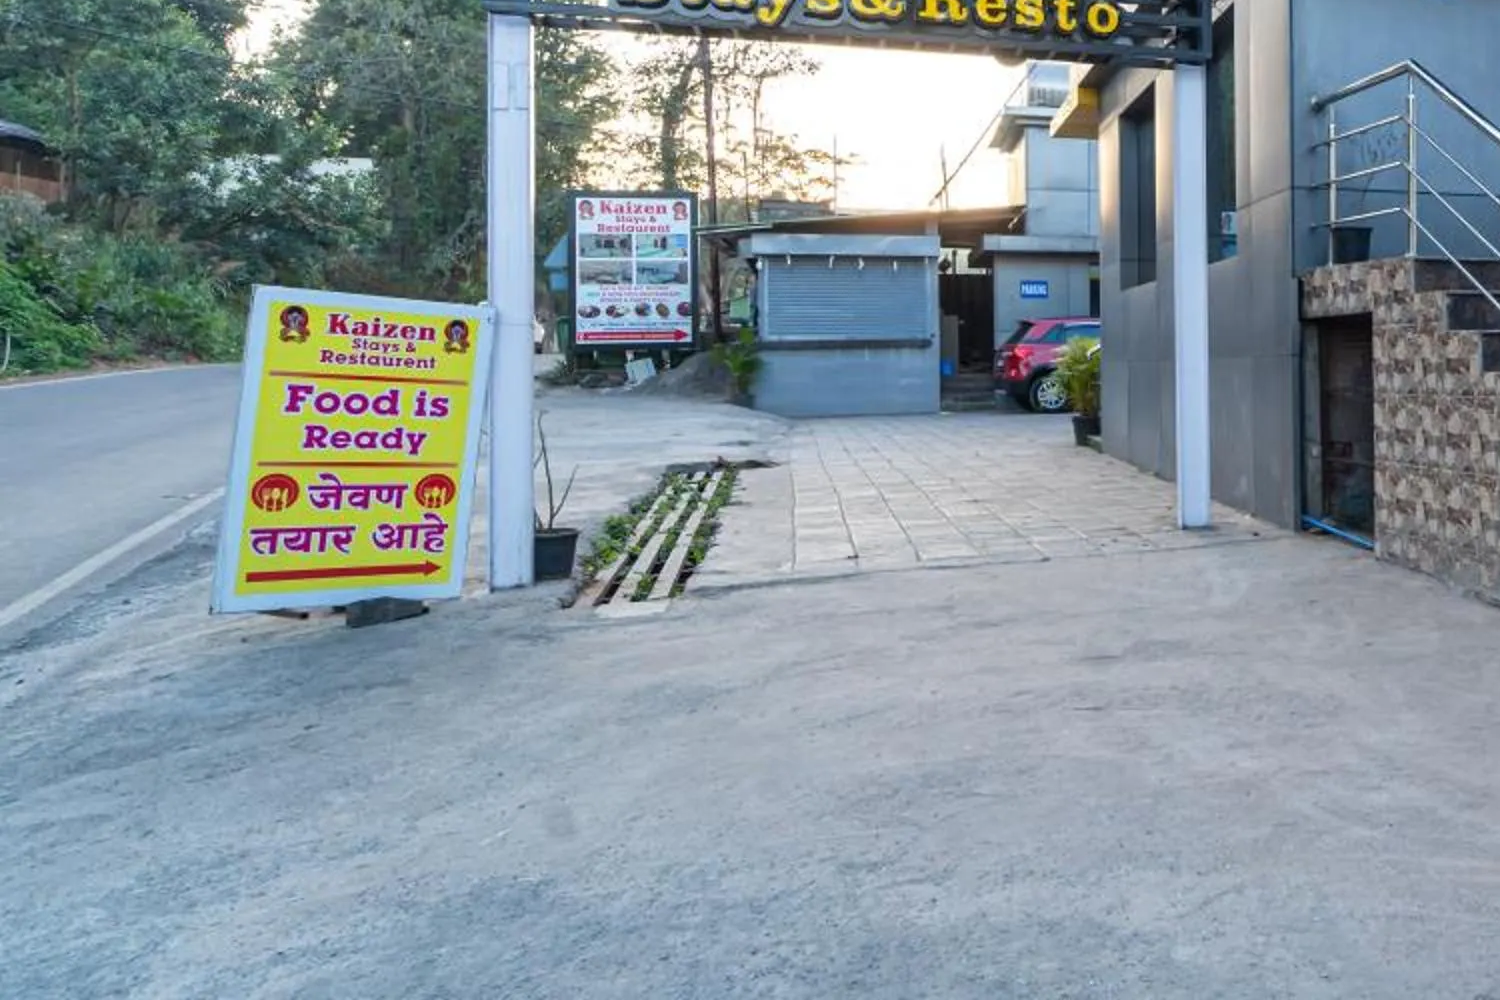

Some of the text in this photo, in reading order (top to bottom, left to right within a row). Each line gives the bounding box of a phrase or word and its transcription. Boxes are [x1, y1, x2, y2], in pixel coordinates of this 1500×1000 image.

[600, 199, 667, 214] Kaizen
[327, 312, 437, 341] Kaizen
[319, 349, 436, 369] Restaurent
[351, 337, 417, 353] Stays &
[284, 384, 449, 418] Food is
[302, 424, 427, 455] Ready
[307, 472, 409, 510] जेवण
[249, 513, 449, 555] तयार आहे
